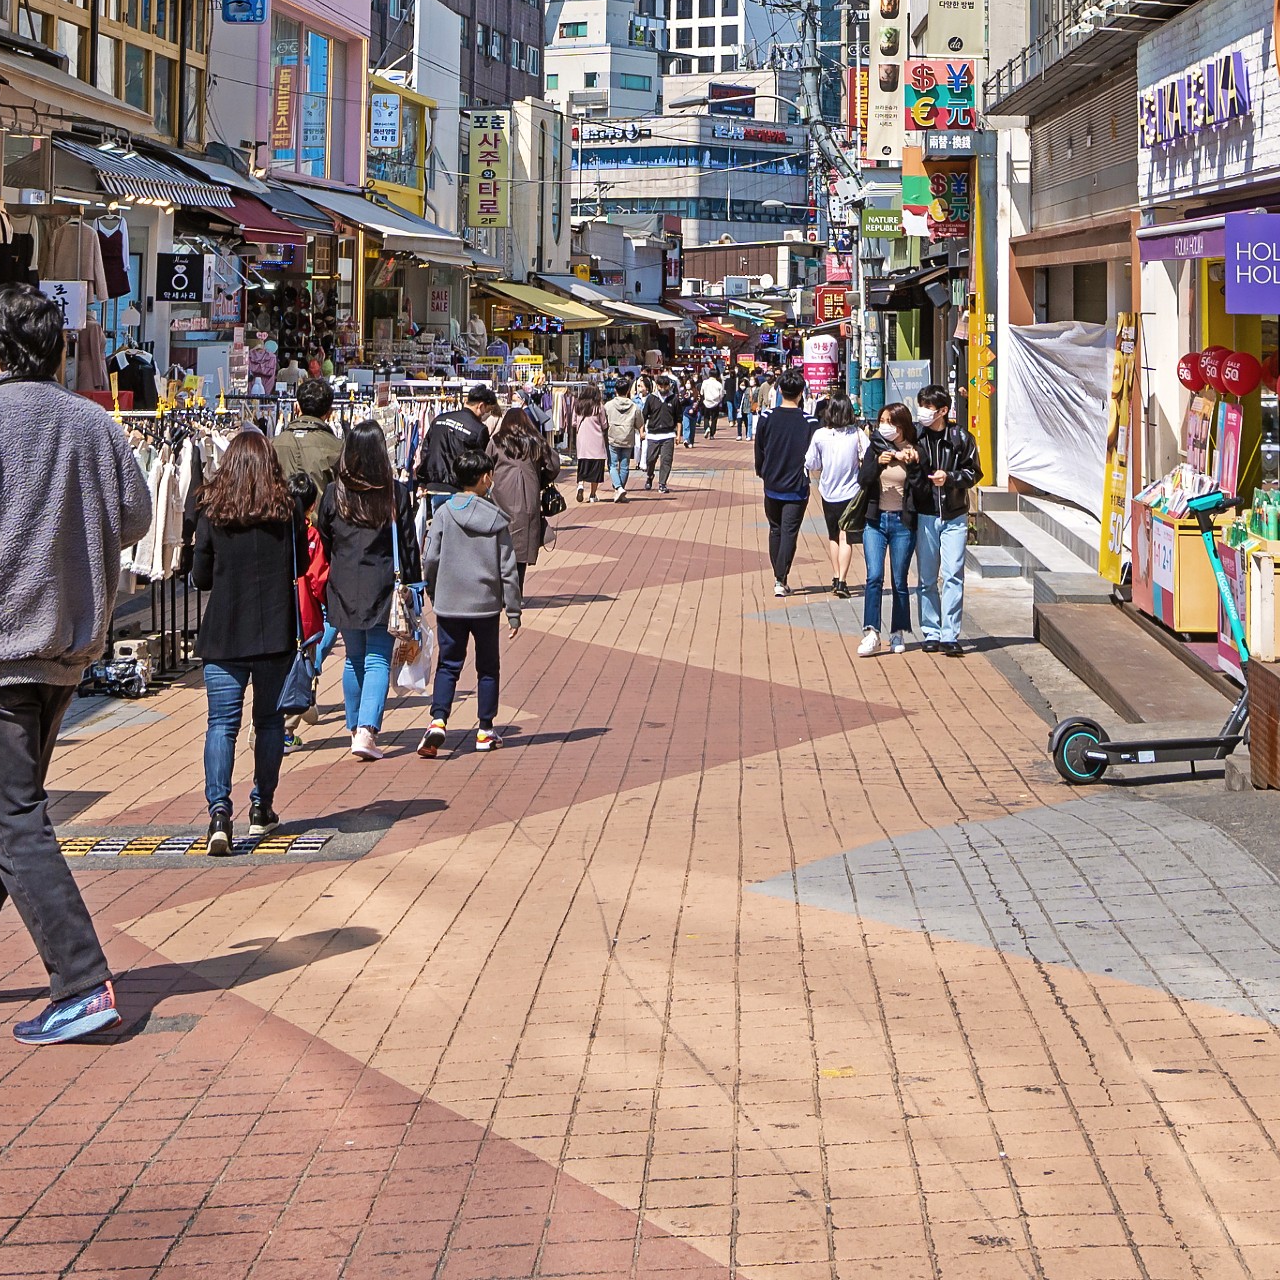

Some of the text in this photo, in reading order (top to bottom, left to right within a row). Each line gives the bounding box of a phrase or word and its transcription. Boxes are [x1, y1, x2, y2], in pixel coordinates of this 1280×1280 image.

[939, 1, 975, 9] 다양한 방법
[473, 115, 506, 129] 포춘
[477, 133, 501, 167] 사주
[483, 170, 496, 179] 와
[477, 181, 501, 216] 타로
[480, 217, 497, 225] 2F
[868, 216, 899, 225] NATURE
[1175, 235, 1204, 256] HOLIKA HOLIKA
[431, 290, 448, 301] SALE
[431, 302, 448, 313] SALE
[1216, 571, 1239, 621] KICKGOING
